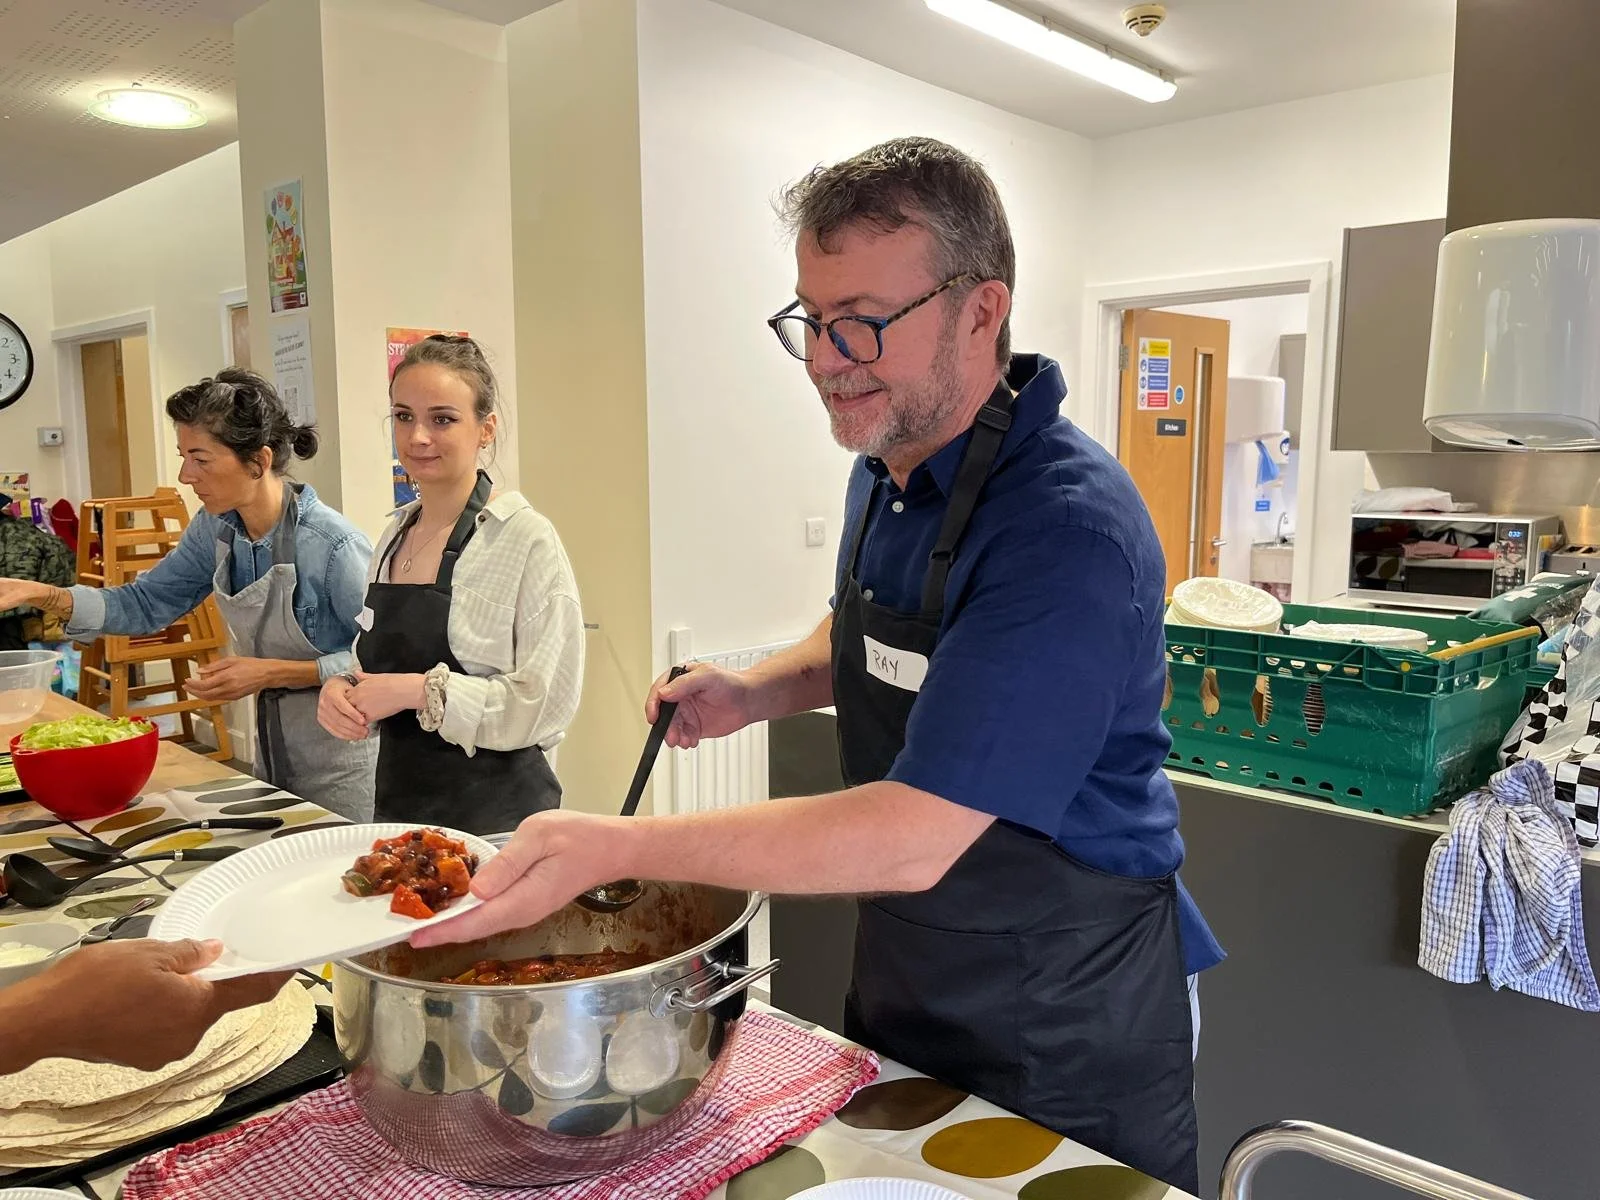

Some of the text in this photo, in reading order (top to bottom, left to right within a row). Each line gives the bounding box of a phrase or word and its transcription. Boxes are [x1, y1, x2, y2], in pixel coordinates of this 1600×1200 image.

[1, 337, 9, 348] 2
[9, 353, 17, 365] 3
[4, 368, 13, 379] 4
[873, 649, 899, 680] RAY
